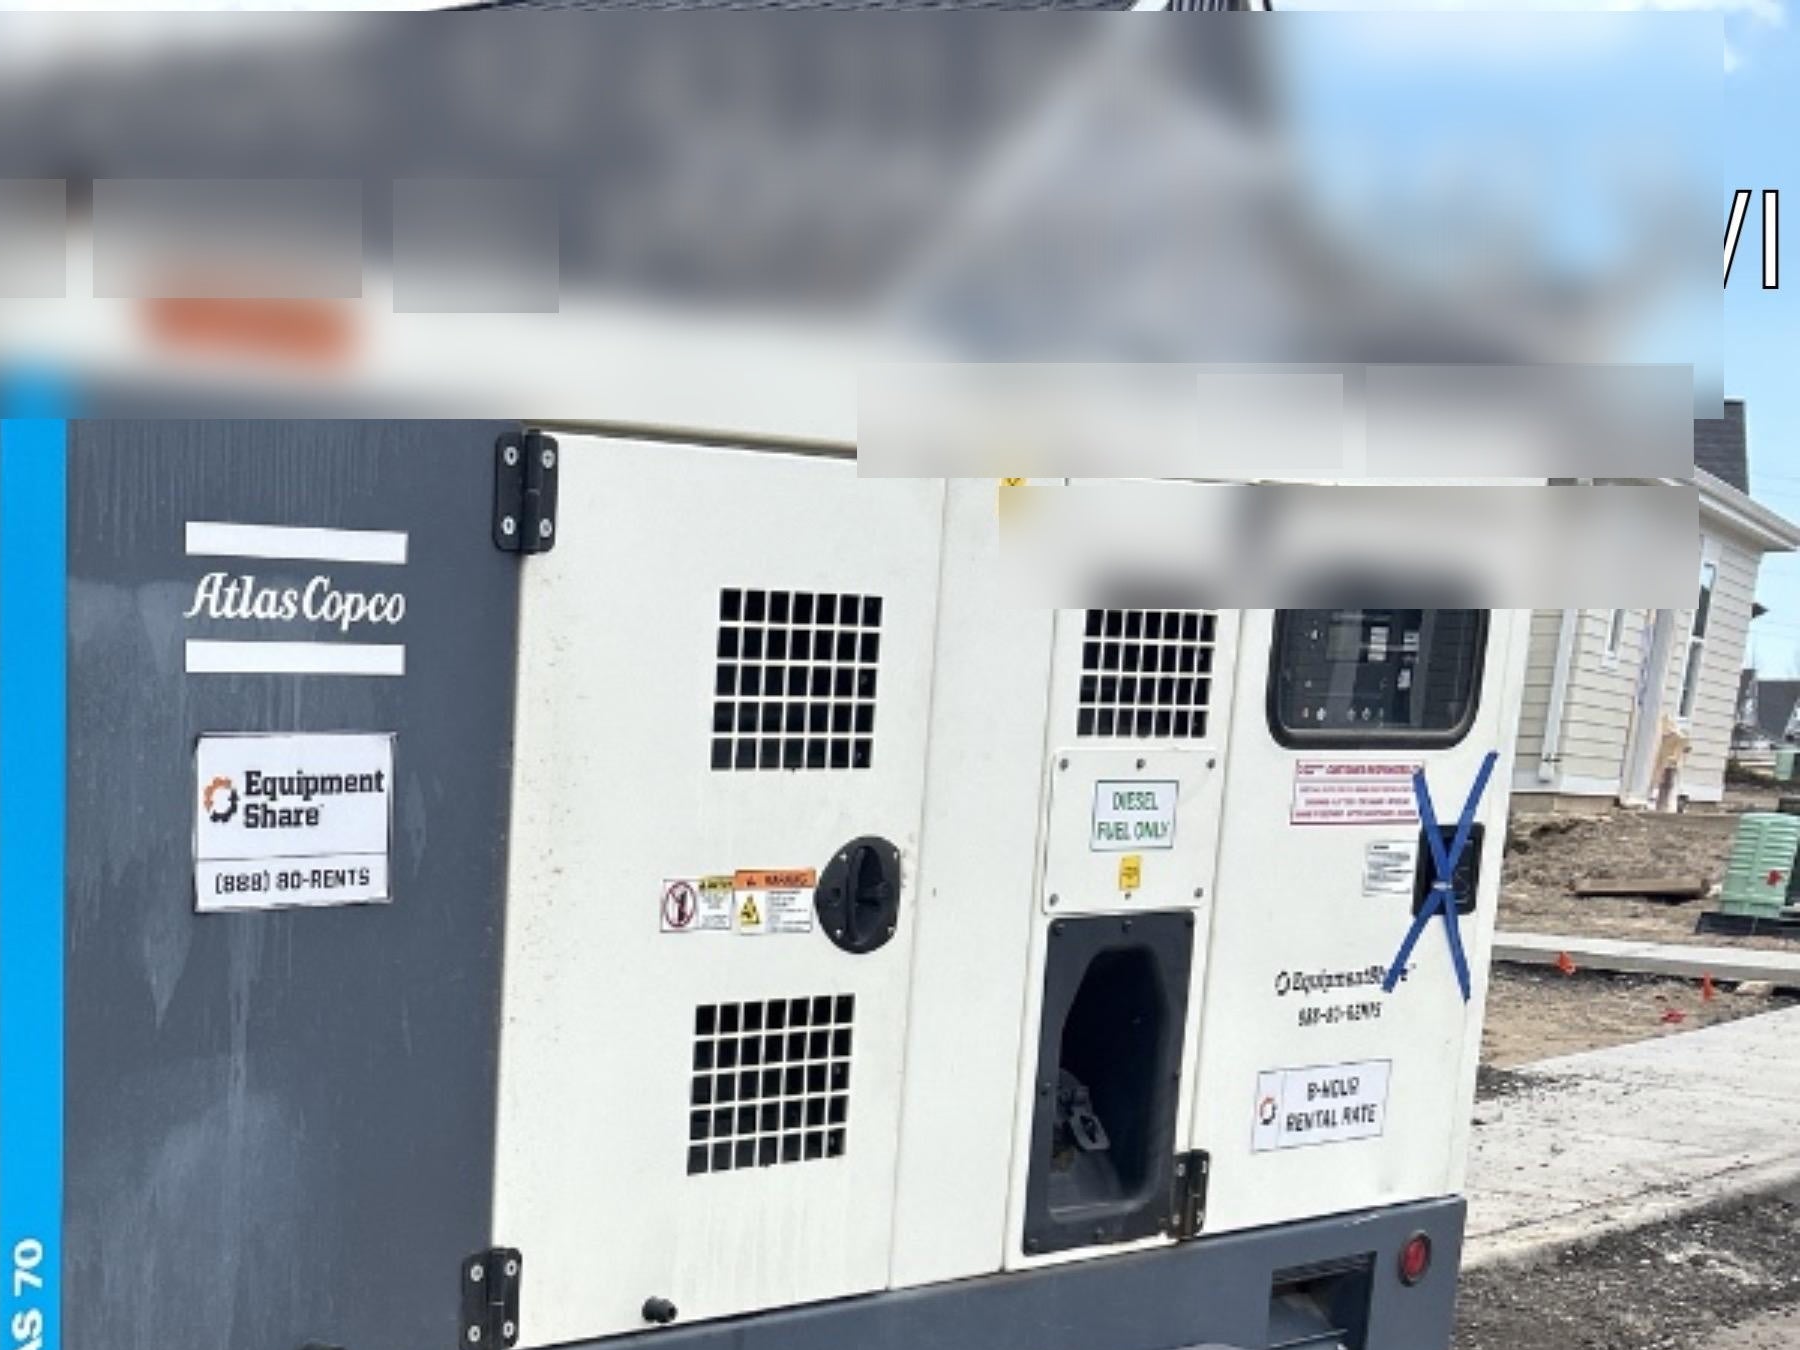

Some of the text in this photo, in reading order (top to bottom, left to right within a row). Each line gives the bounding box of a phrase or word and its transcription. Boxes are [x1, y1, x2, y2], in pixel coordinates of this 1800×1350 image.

[183, 571, 406, 632] Atlas Copco
[243, 769, 385, 801] Equipment
[1112, 791, 1159, 811] DIESEL
[243, 803, 320, 830] Share
[1097, 821, 1171, 841] FUEL ONLY
[214, 867, 370, 895] (888) 80-RENTS
[1286, 1103, 1378, 1132] RENTAL RATE
[13, 1238, 43, 1297] 70
